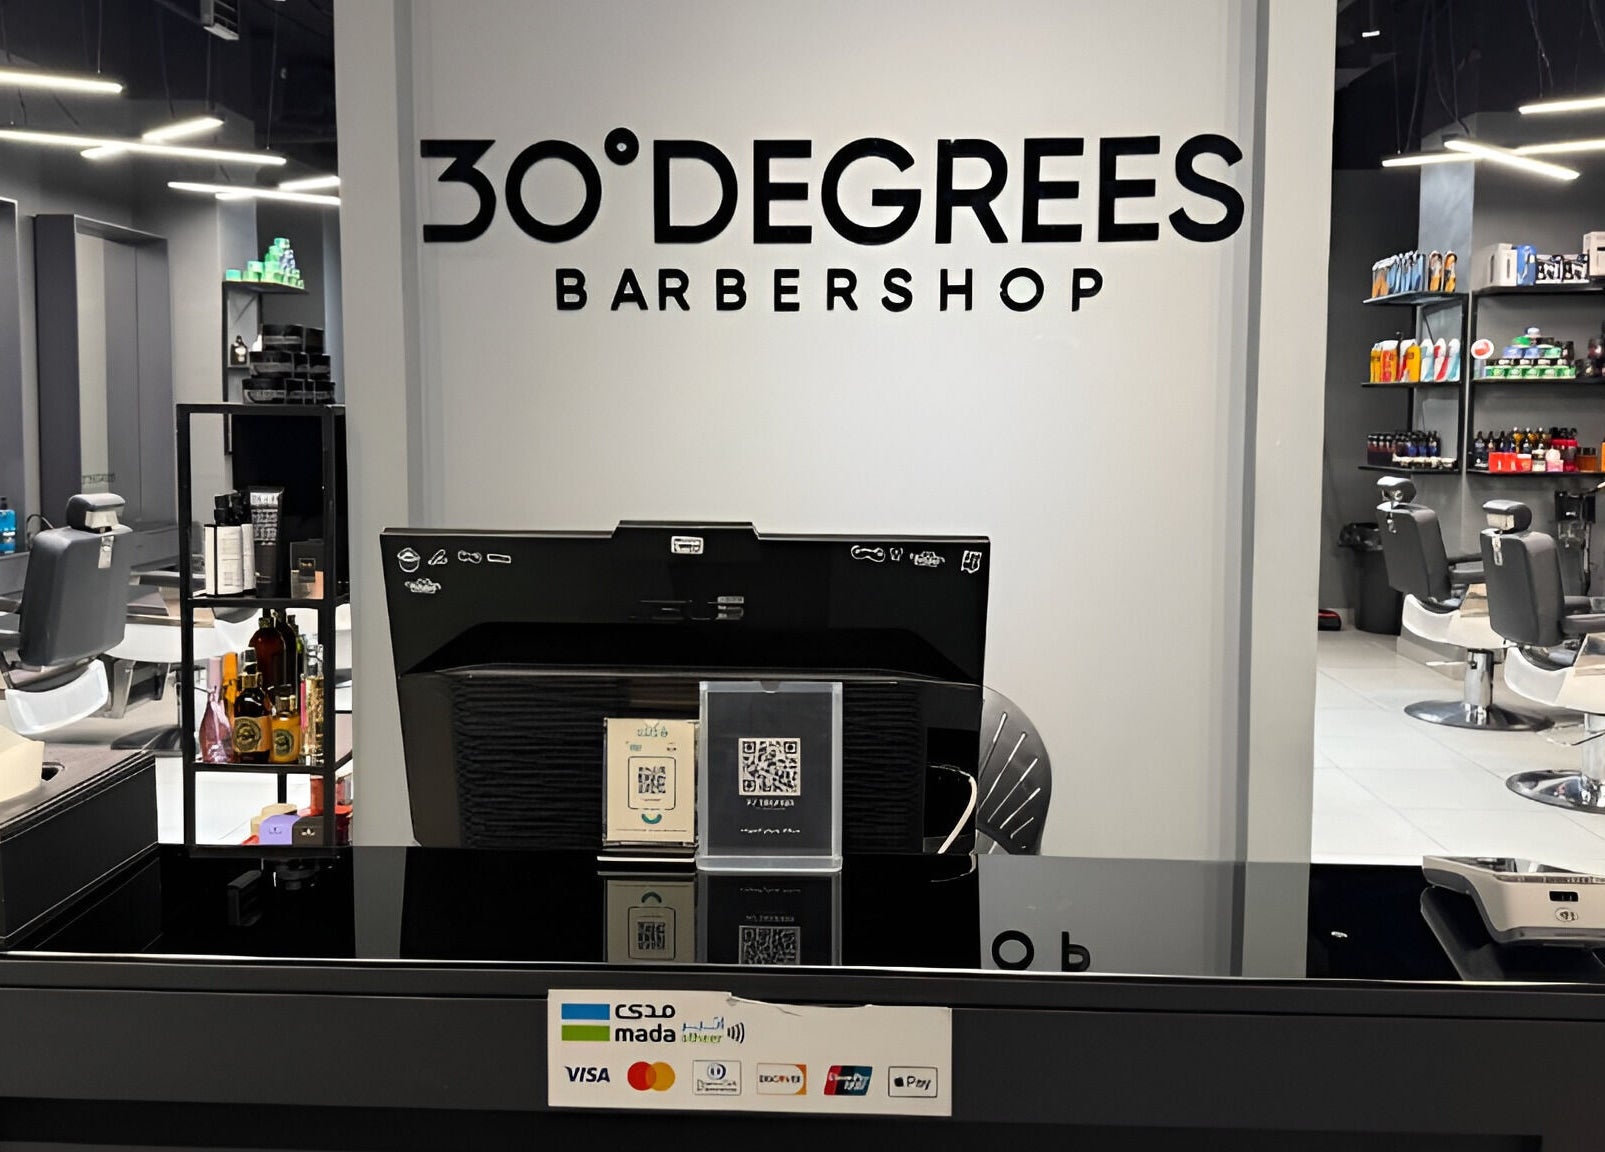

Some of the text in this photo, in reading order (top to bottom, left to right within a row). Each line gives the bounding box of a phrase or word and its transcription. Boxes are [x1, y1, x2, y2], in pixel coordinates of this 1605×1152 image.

[555, 267, 1103, 313] BARBERSHOP
[614, 1023, 676, 1043] mada
[564, 1066, 611, 1083] VISA
